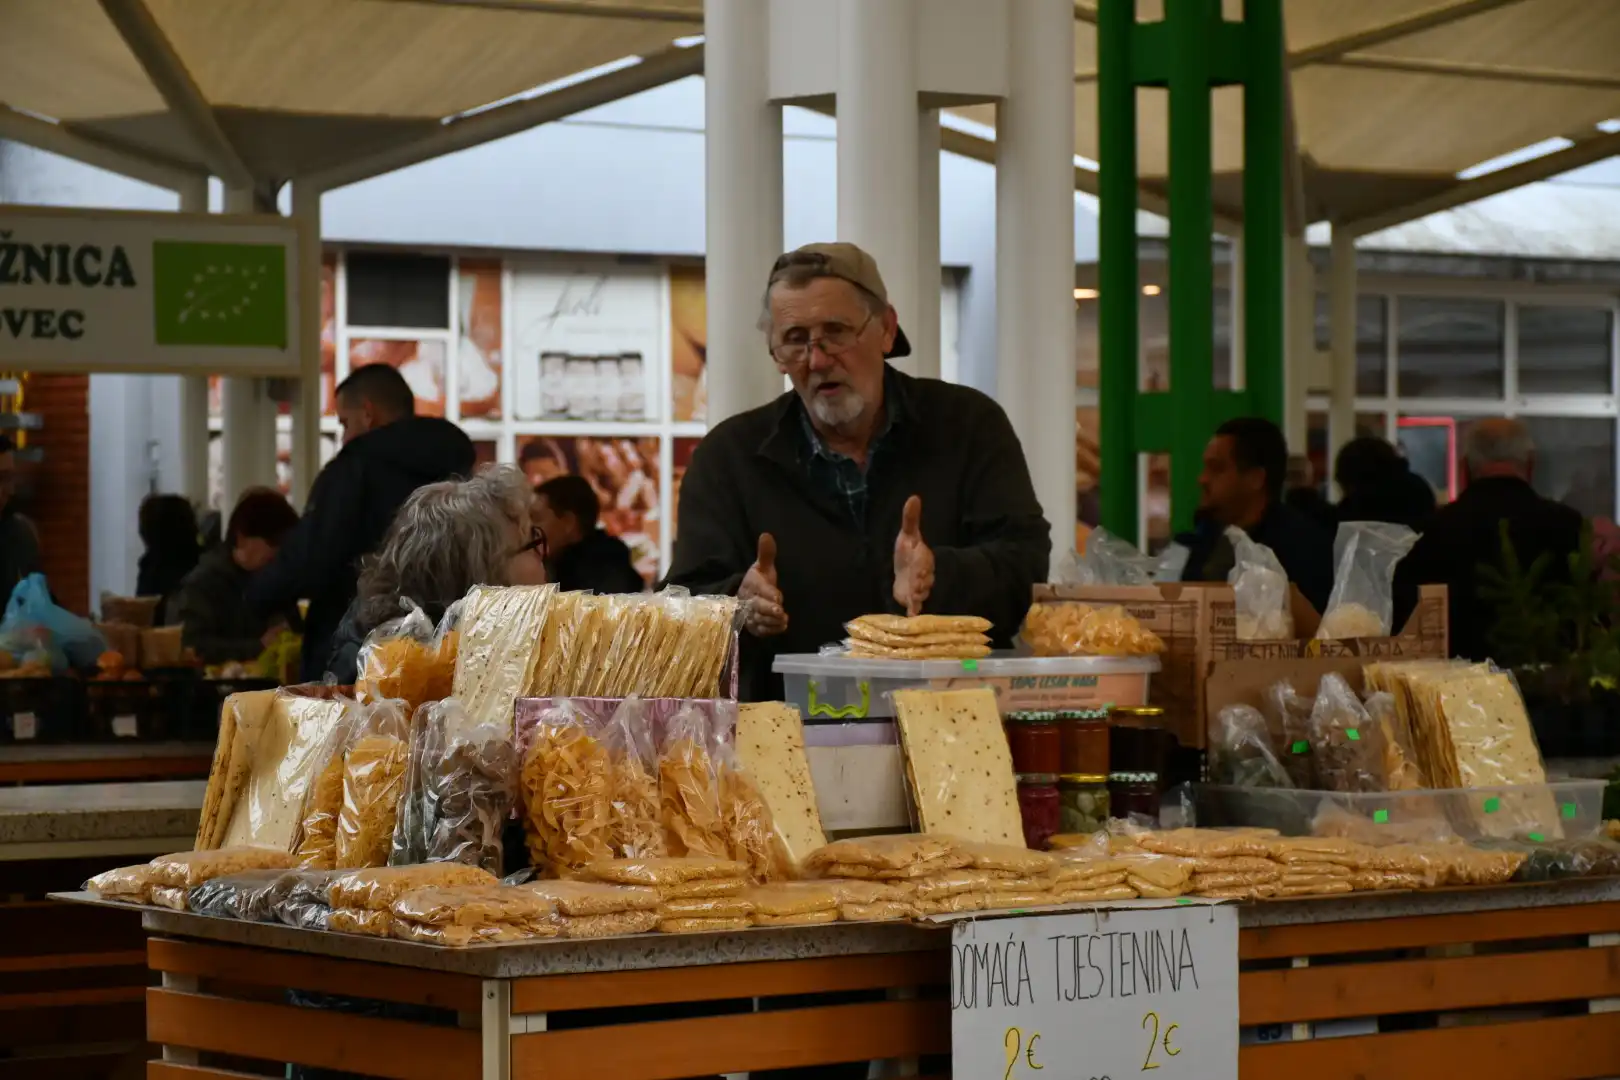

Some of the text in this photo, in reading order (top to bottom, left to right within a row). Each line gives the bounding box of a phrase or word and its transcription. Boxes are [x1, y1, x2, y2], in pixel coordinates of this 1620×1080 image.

[0, 309, 86, 340] VEC
[951, 927, 1199, 1011] DOMAĆA TJESTENINA
